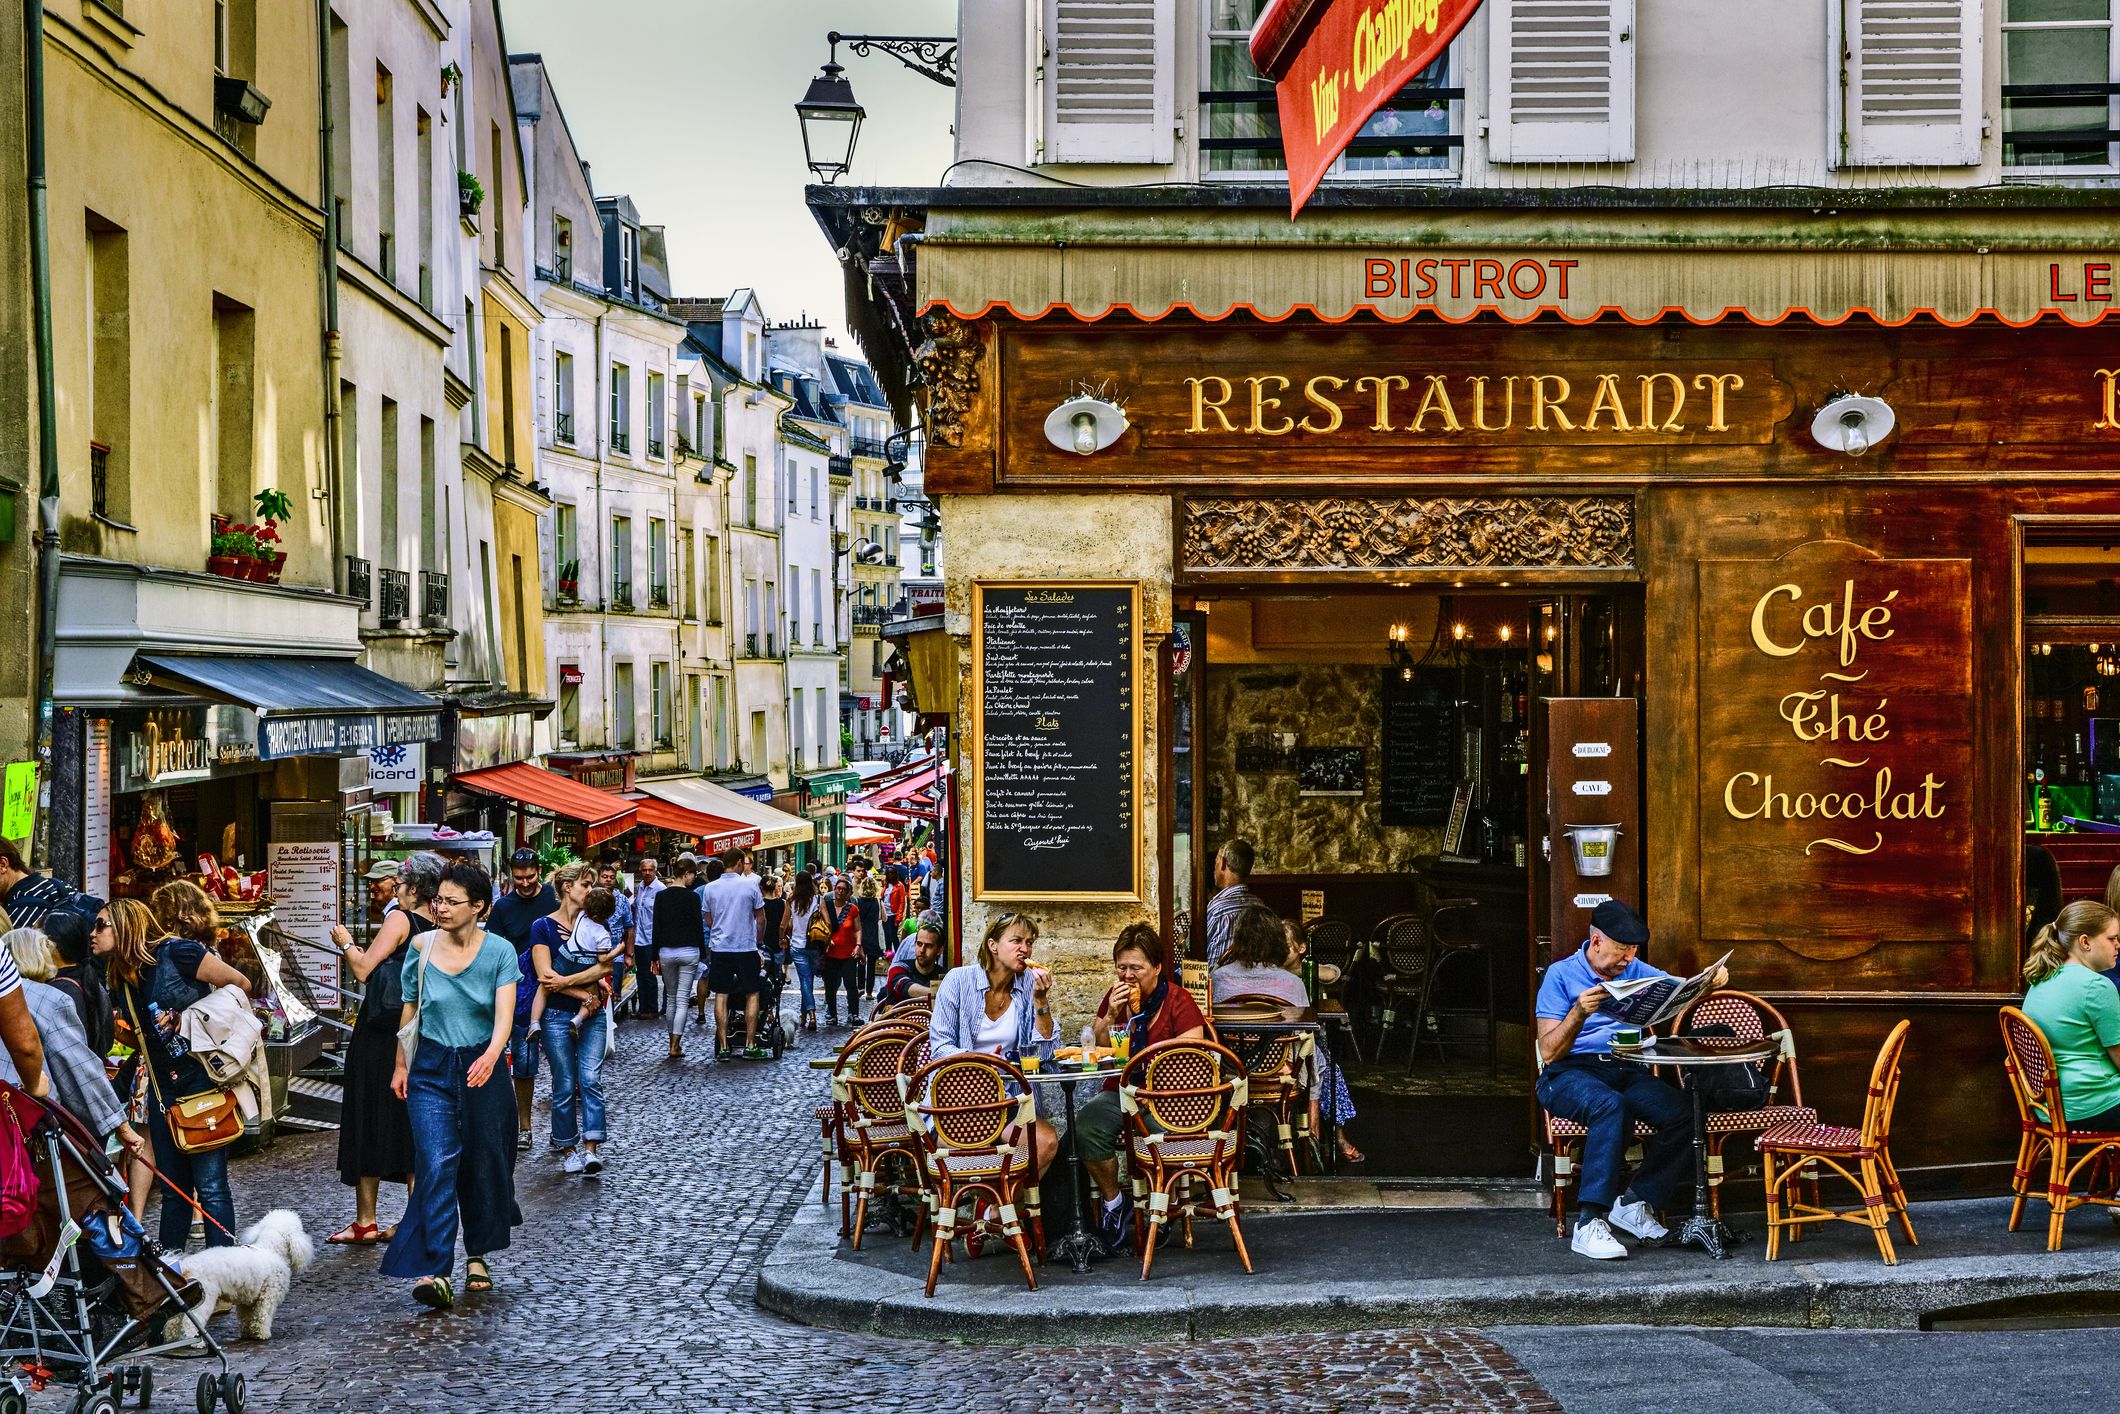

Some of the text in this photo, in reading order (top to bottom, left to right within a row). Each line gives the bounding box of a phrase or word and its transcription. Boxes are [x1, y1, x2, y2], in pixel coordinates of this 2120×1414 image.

[1310, 65, 1339, 147] Vins
[1353, 0, 1443, 93] Champag
[1364, 258, 1580, 300] BISTROT
[2050, 263, 2113, 302] LE
[1183, 374, 1745, 436] RESTAURANT
[1024, 590, 1074, 601] Les Salades
[1750, 579, 1900, 668] Café
[1034, 717, 1059, 728] Plats
[1779, 689, 1891, 742] Thé
[367, 768, 416, 780] icard
[1581, 784, 1603, 792] CAVE
[1723, 766, 1946, 820] Chocolat
[277, 845, 331, 855] La Rotisserie
[1183, 963, 1208, 972] BREAKFAST
